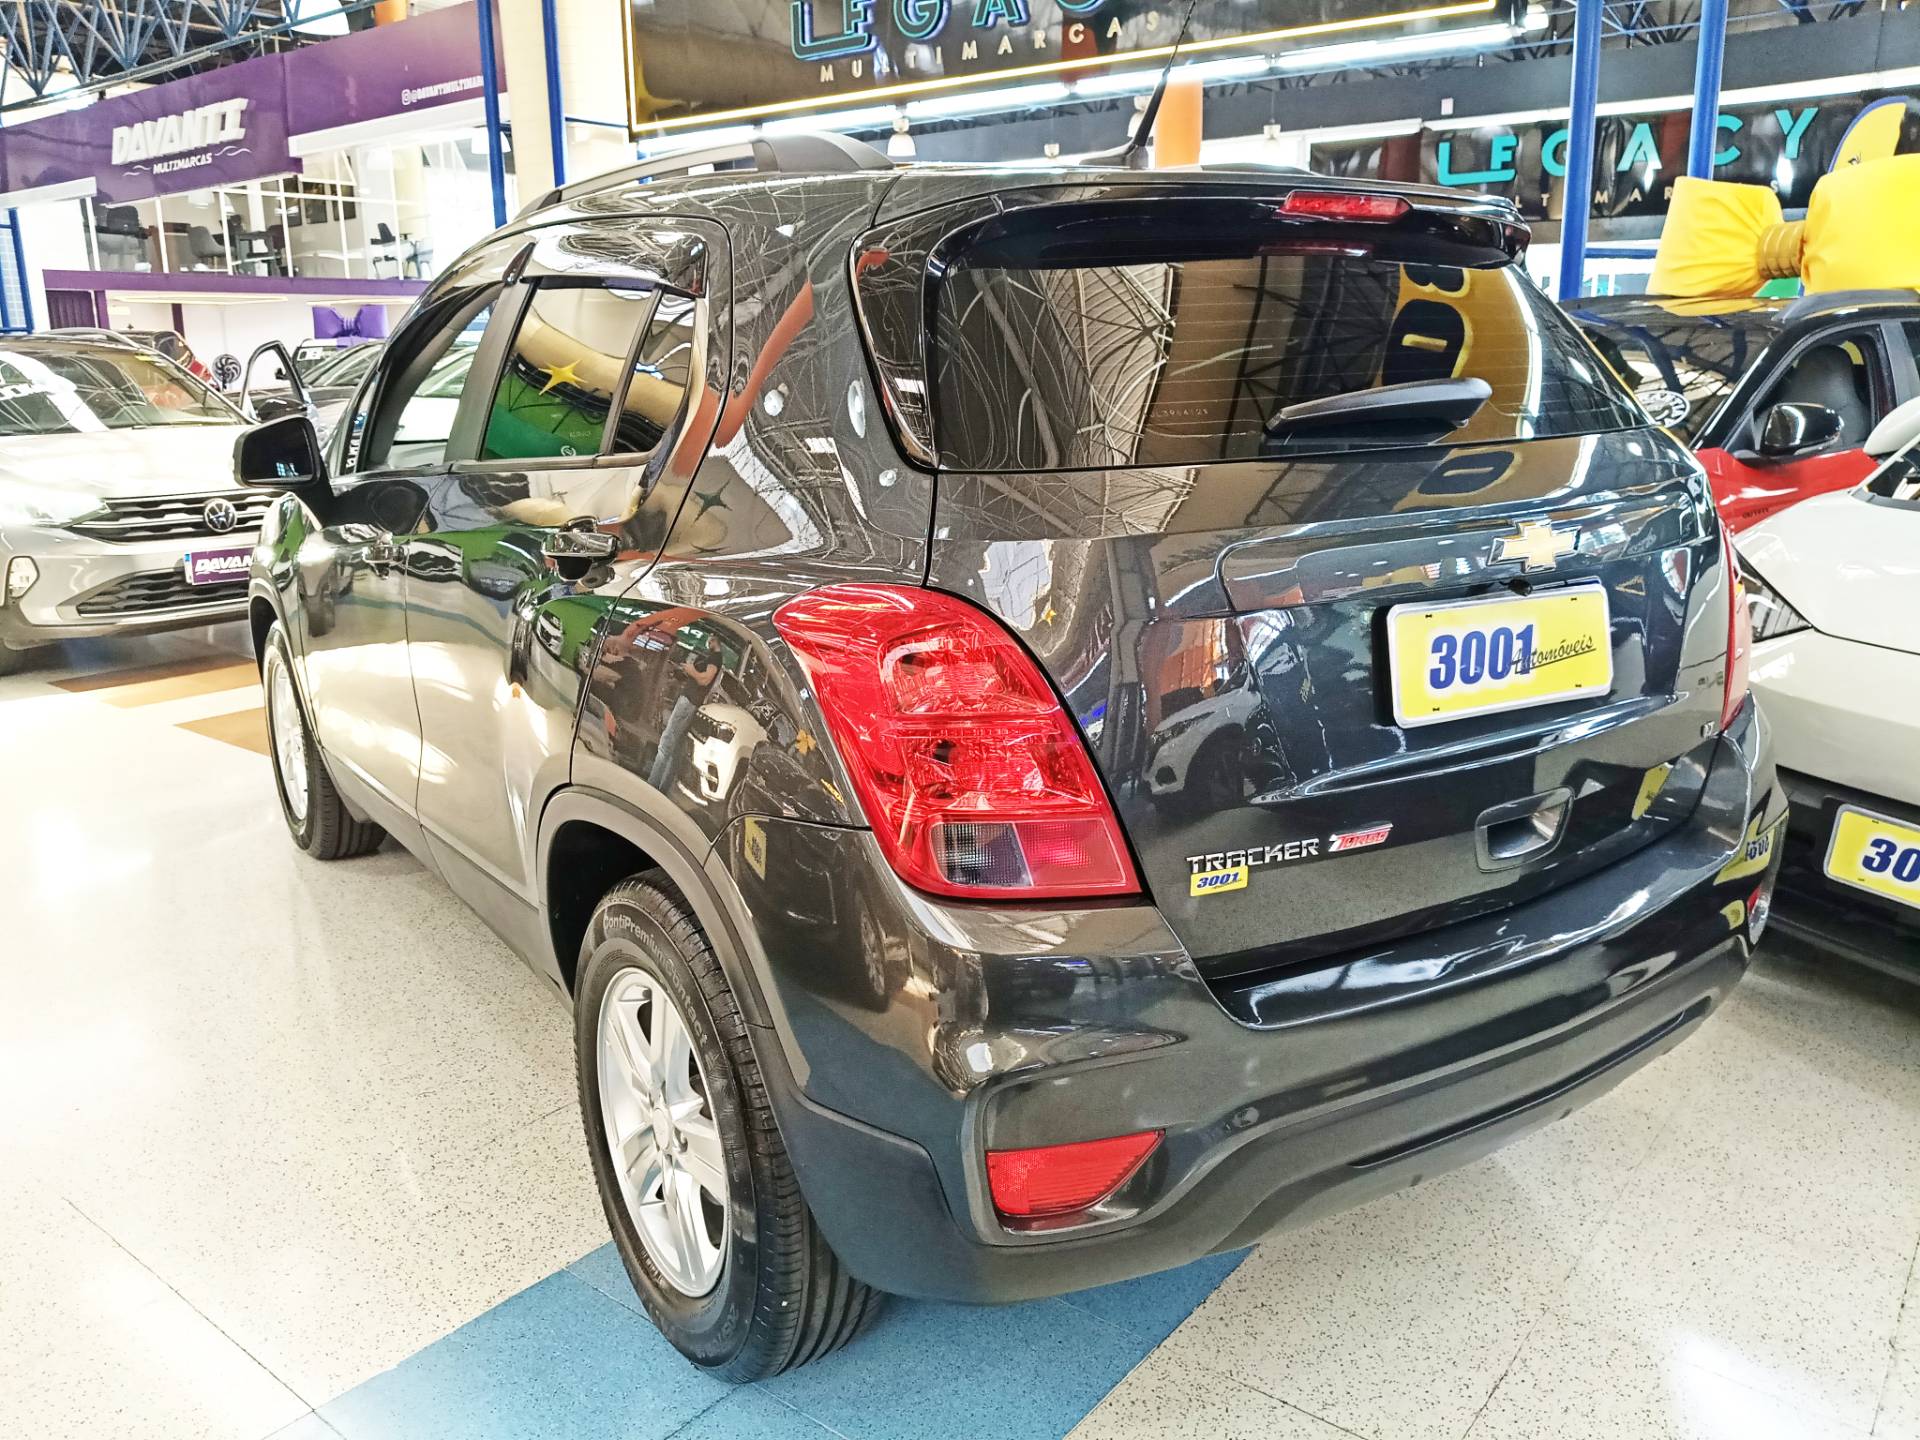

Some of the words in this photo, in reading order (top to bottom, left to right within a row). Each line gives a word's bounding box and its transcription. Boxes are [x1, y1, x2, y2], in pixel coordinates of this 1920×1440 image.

[111, 97, 249, 165] DAVANTI
[153, 153, 212, 174] MULTIMARCAS
[1429, 624, 1534, 690] 3001
[1186, 838, 1320, 874] TRACKER
[1196, 872, 1240, 889] 3001
